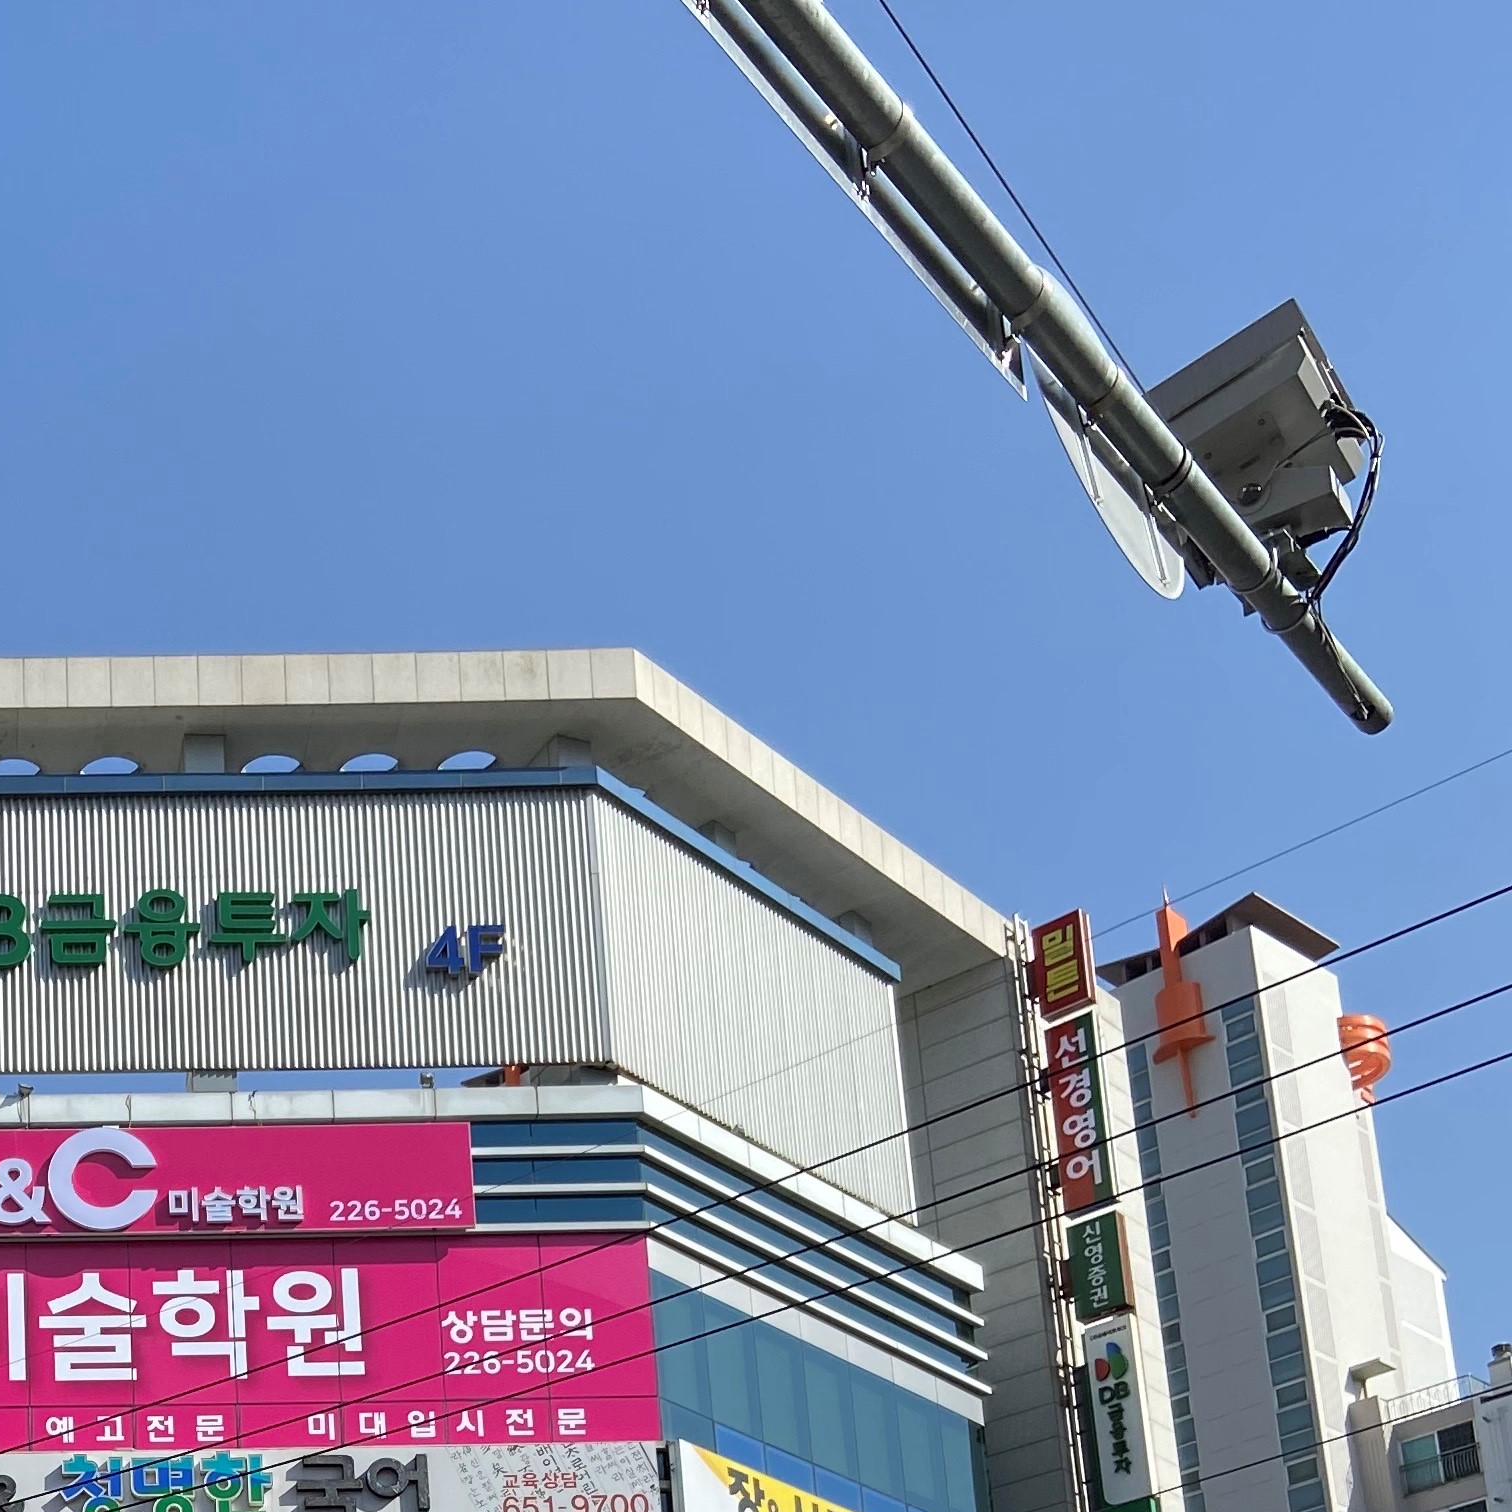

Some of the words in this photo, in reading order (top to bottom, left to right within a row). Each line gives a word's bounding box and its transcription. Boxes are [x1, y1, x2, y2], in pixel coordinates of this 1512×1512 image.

[426, 922, 505, 976] 4F
[1054, 1028, 1102, 1186] 선경영어
[167, 1185, 305, 1224] 미술학원
[329, 1198, 463, 1222] 226-5024
[440, 1308, 595, 1345] 상담문의
[442, 1348, 596, 1376] 226-5024
[1098, 1381, 1131, 1405] DB
[46, 1413, 226, 1446] 예고전문
[308, 1408, 588, 1440] 미대입시전문
[502, 1472, 577, 1489] 교육상담
